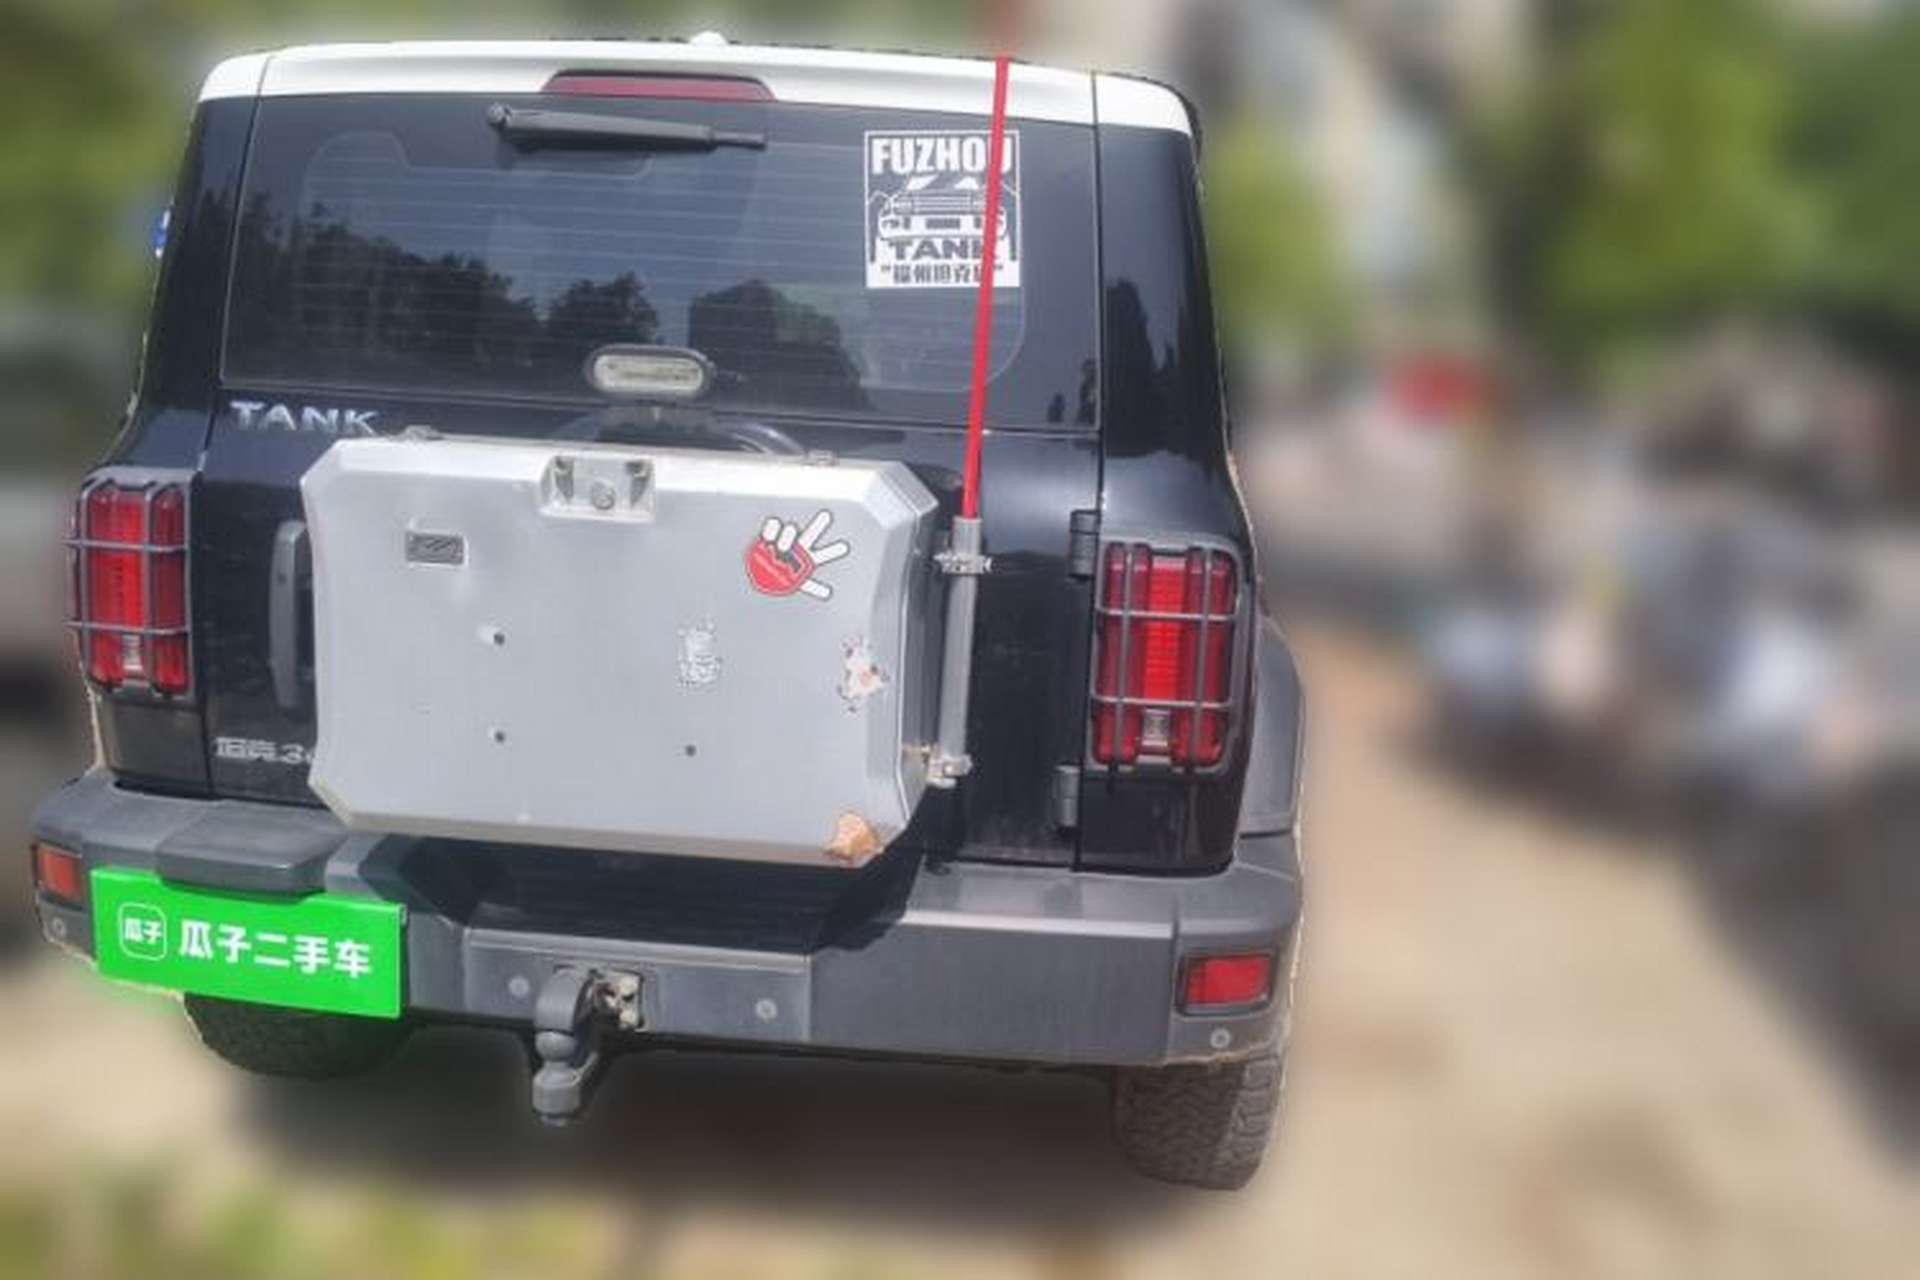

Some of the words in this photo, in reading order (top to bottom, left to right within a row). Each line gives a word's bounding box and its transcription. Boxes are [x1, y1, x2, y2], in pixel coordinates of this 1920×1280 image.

[871, 136, 1013, 175] FUZHOU
[229, 401, 379, 435] TANK
[124, 917, 163, 945] 瓜子
[178, 919, 371, 978] 瓜子二手车
